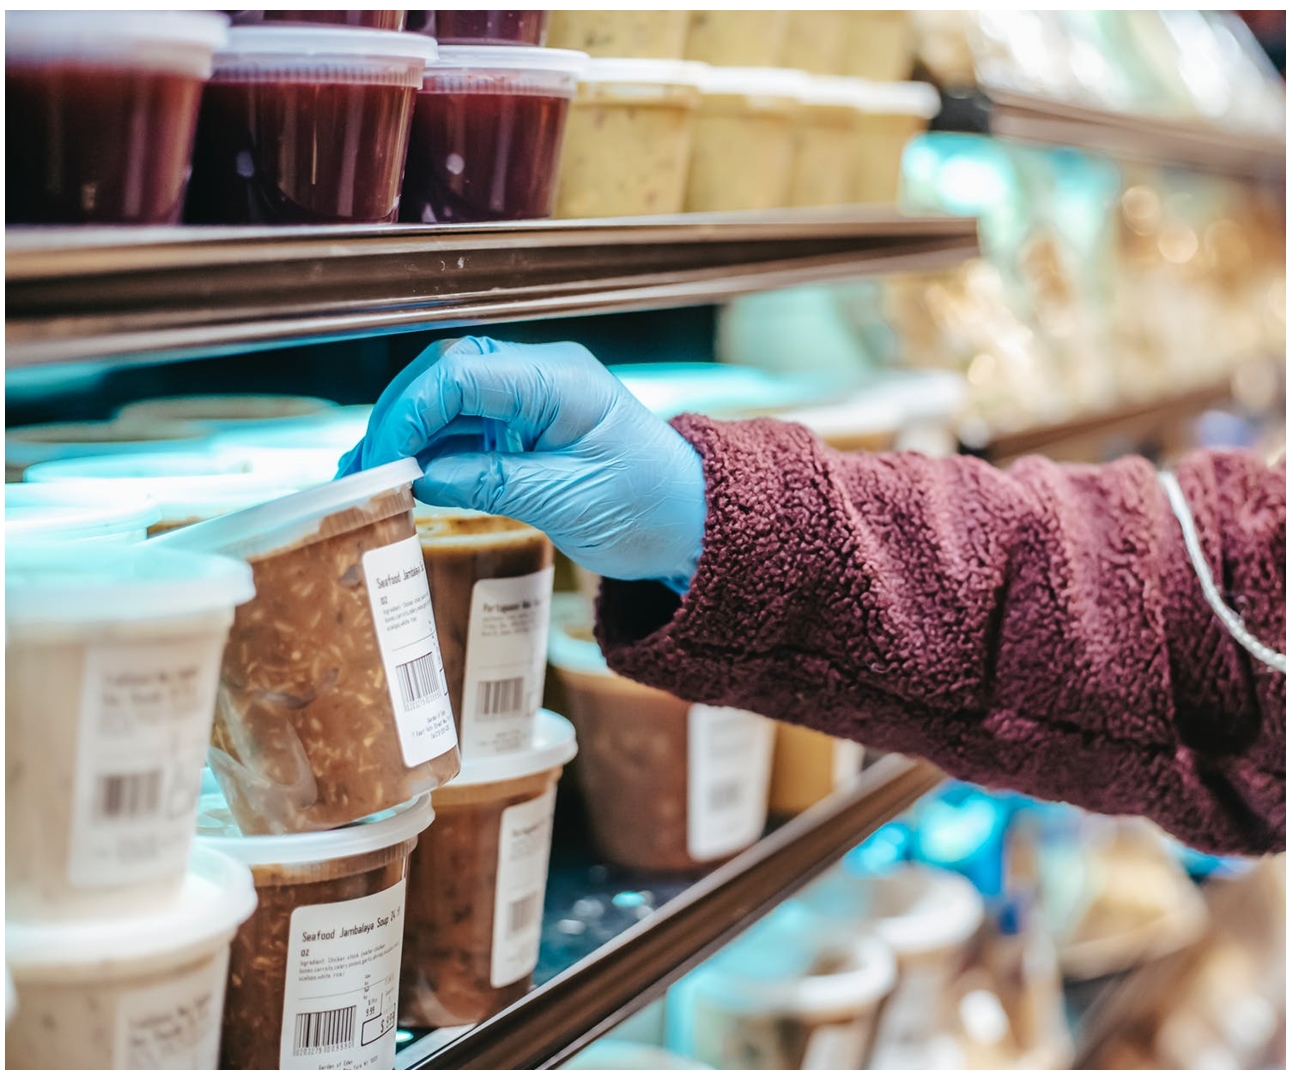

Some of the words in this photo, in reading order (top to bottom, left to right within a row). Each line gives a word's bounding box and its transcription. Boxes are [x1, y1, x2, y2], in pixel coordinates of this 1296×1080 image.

[376, 572, 402, 588] Seafood
[302, 929, 336, 942] Seafood
[339, 923, 375, 938] Jambalaya
[376, 916, 389, 928] Soup
